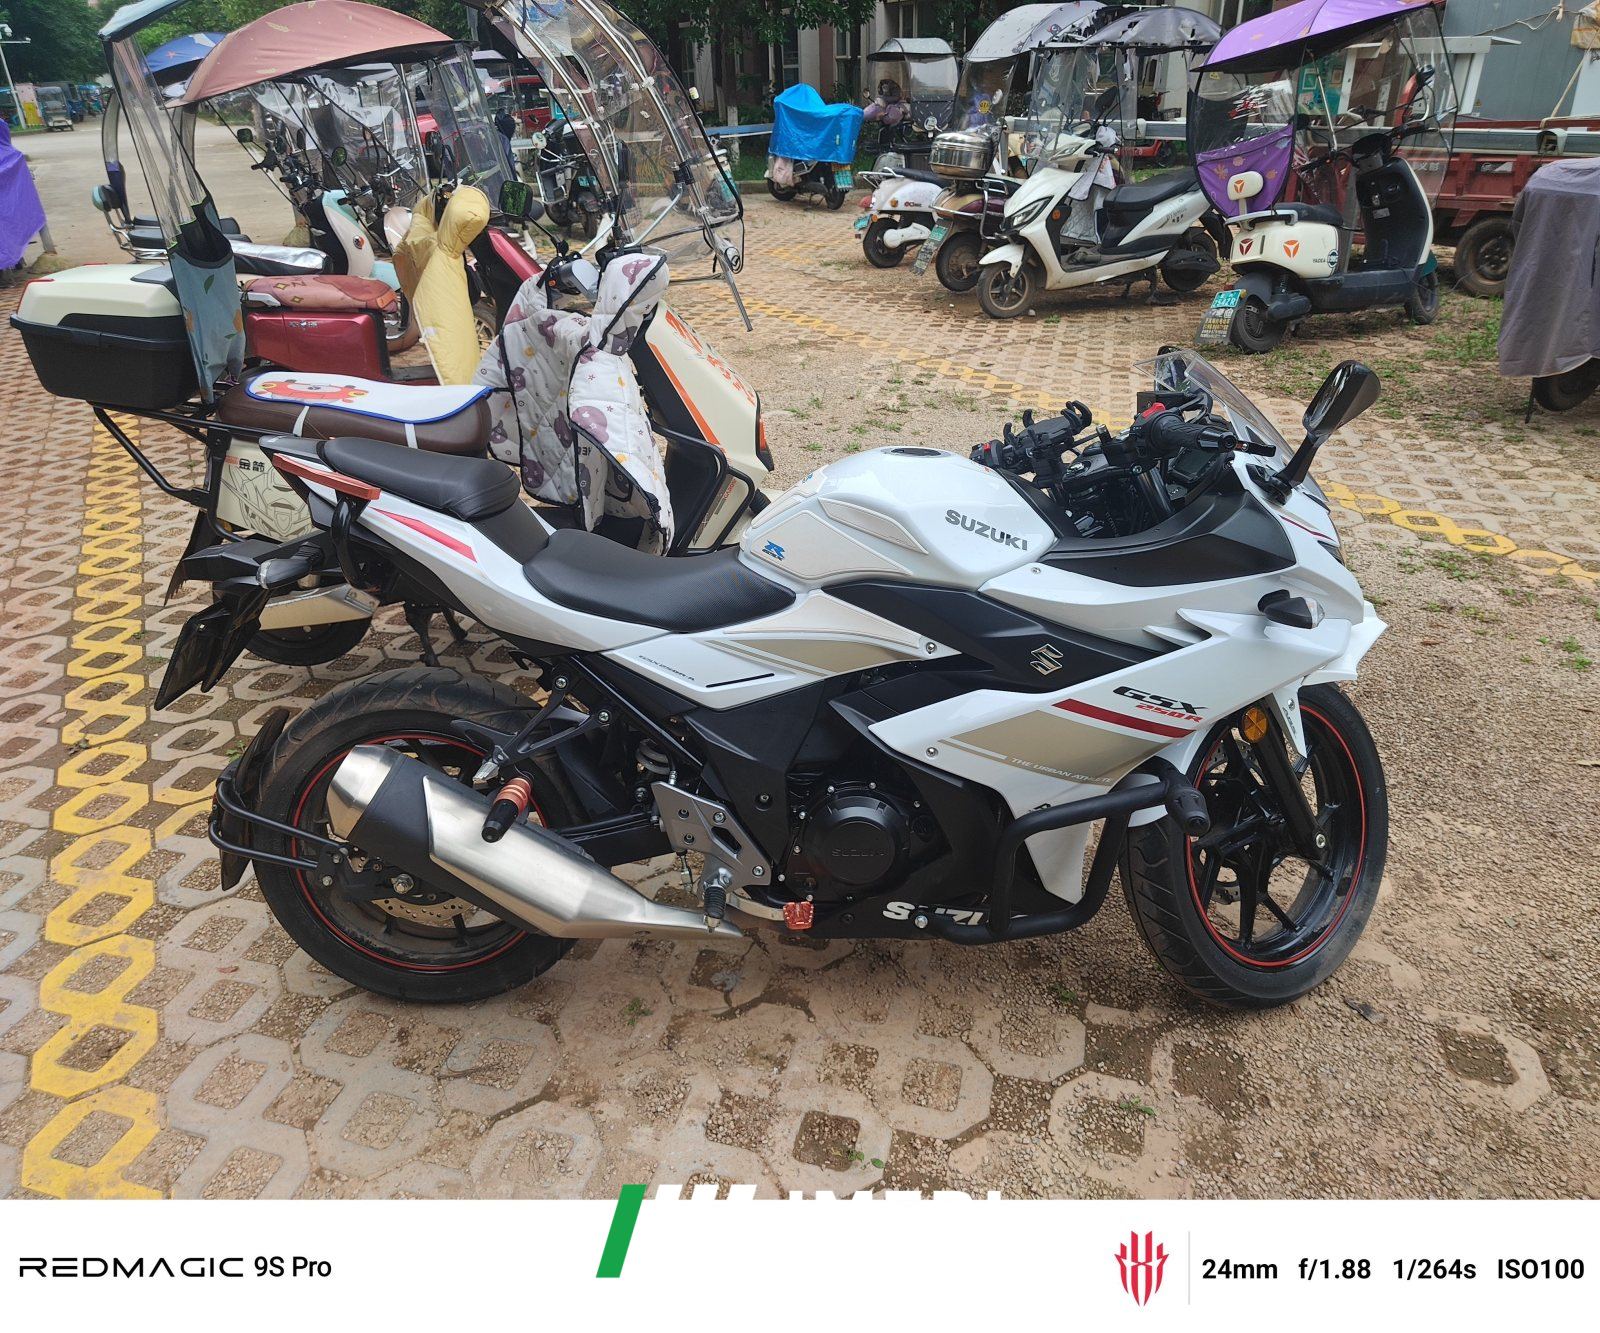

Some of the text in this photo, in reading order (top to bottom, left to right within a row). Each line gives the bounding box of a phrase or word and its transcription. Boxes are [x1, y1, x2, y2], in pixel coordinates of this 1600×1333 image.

[239, 458, 265, 472] 金箭
[944, 509, 1028, 551] SUZUKI
[1112, 685, 1208, 715] GSX
[1135, 703, 1204, 723] 250R
[1011, 757, 1033, 768] THE
[1033, 764, 1071, 777] URBAN
